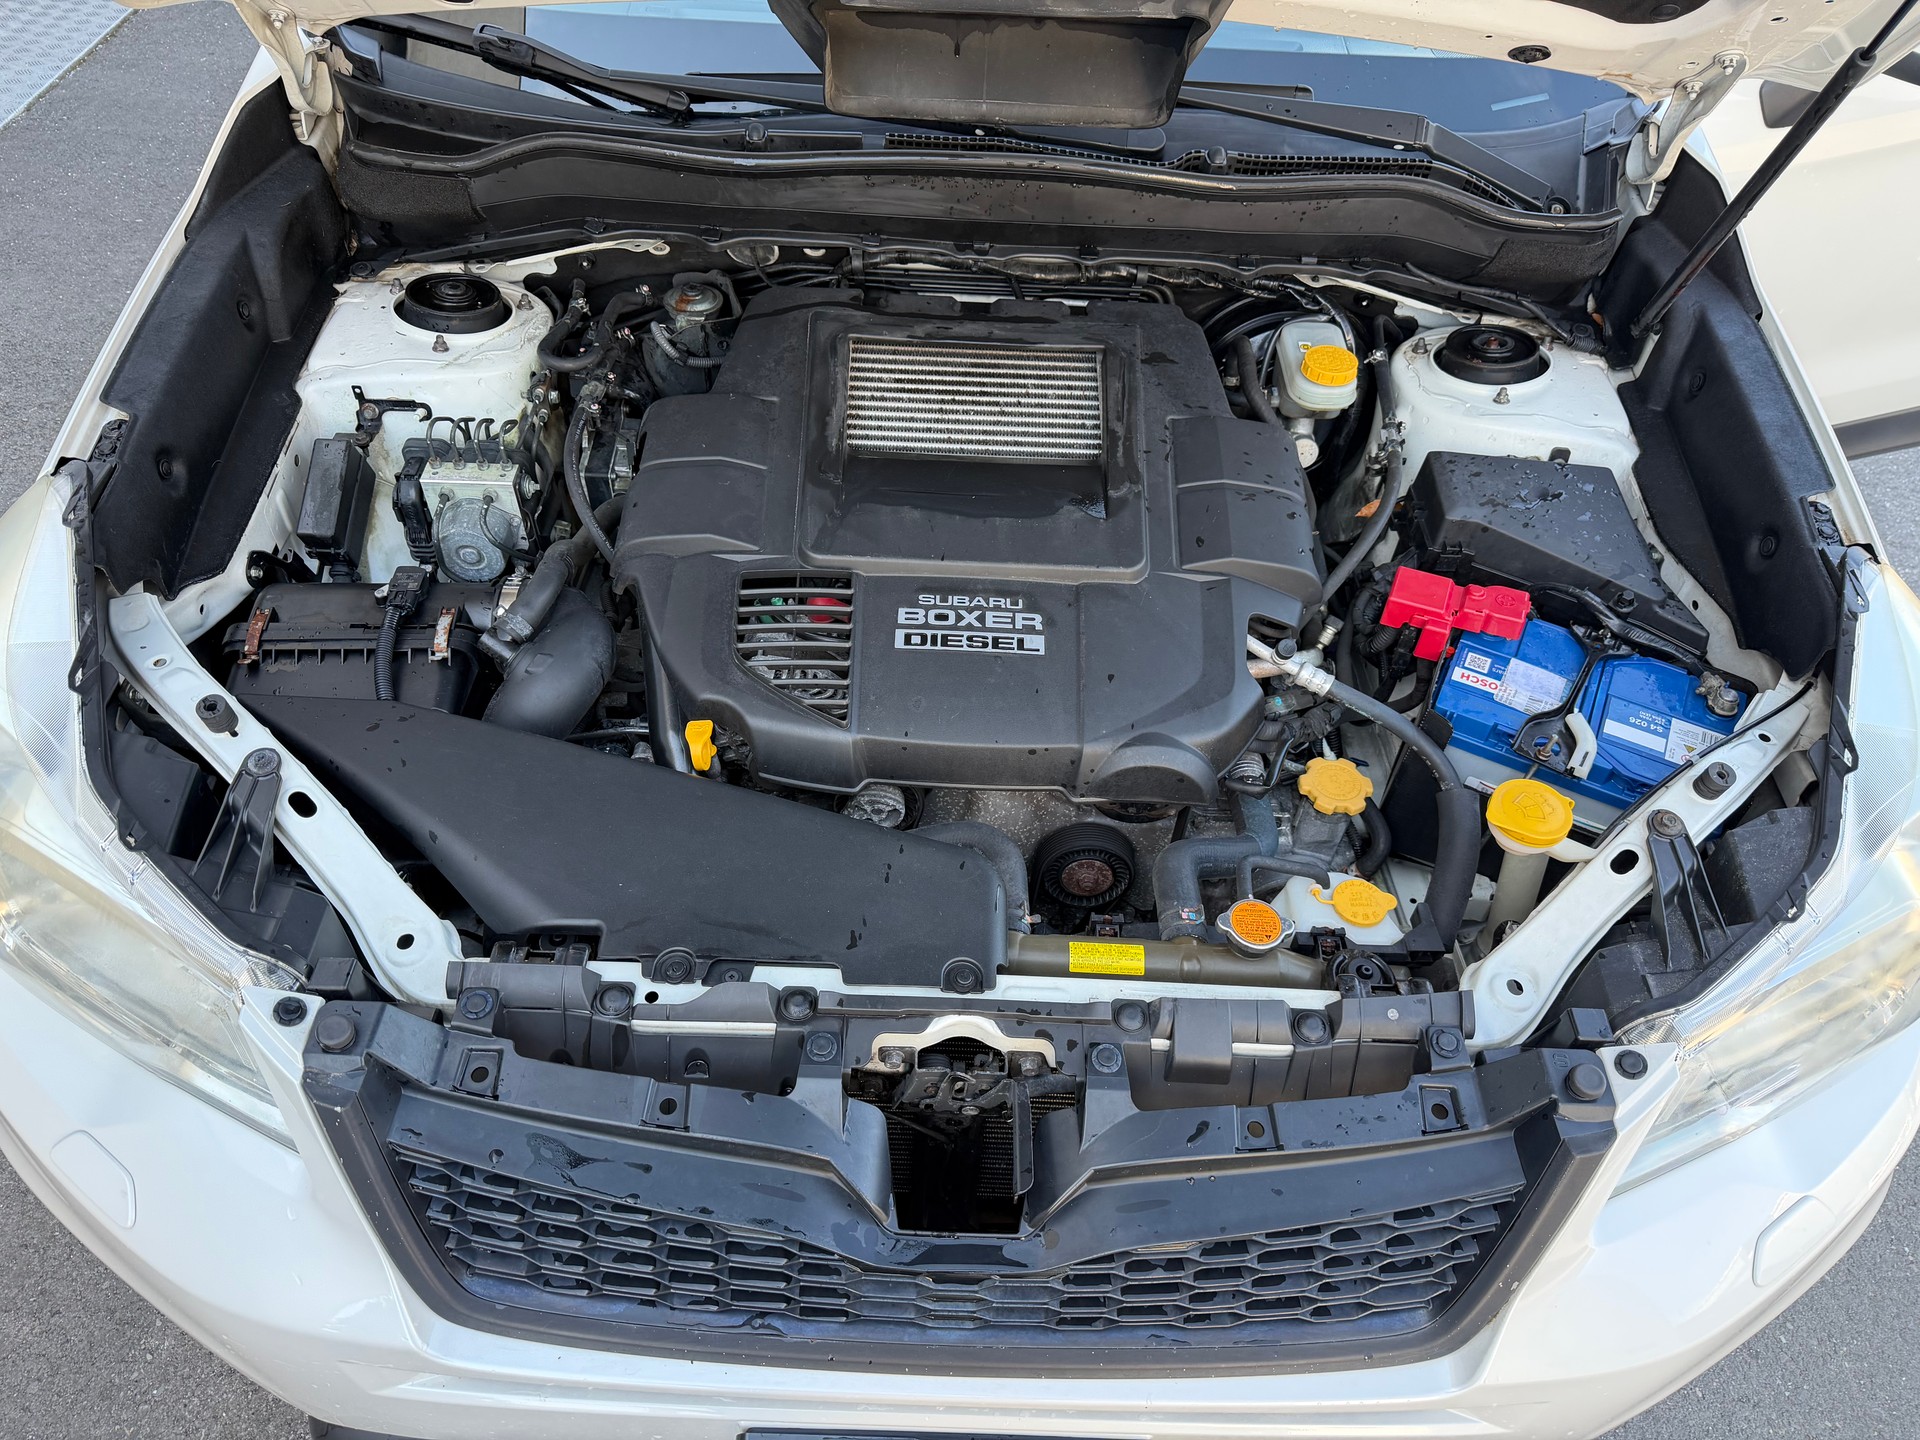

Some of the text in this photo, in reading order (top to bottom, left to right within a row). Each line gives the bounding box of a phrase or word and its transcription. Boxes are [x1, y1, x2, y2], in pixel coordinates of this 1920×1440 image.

[918, 594, 1023, 609] SUBARU
[897, 607, 1043, 630] BOXER
[902, 631, 1042, 653] DIESEL
[1460, 672, 1499, 691] OSCH
[1629, 716, 1648, 728] 026
[1650, 724, 1663, 733] S4
